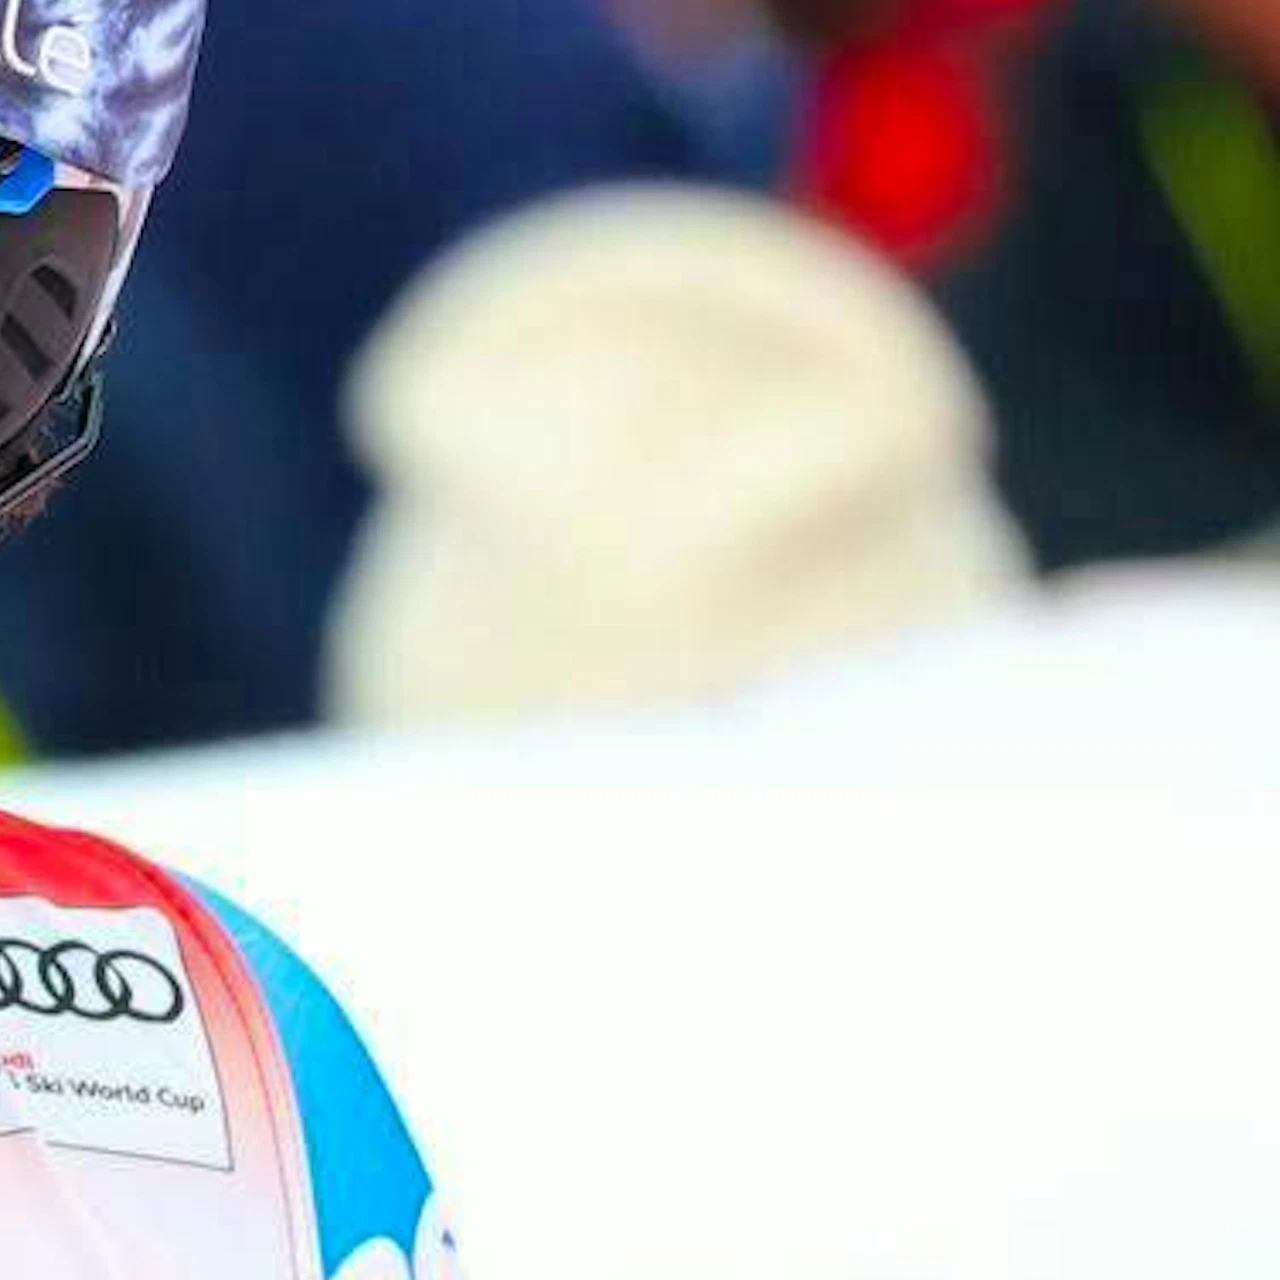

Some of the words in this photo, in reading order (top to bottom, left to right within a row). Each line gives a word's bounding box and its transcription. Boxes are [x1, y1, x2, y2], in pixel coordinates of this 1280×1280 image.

[25, 1073, 65, 1095] Ski
[68, 1077, 151, 1105] World
[155, 1086, 206, 1115] Cup
